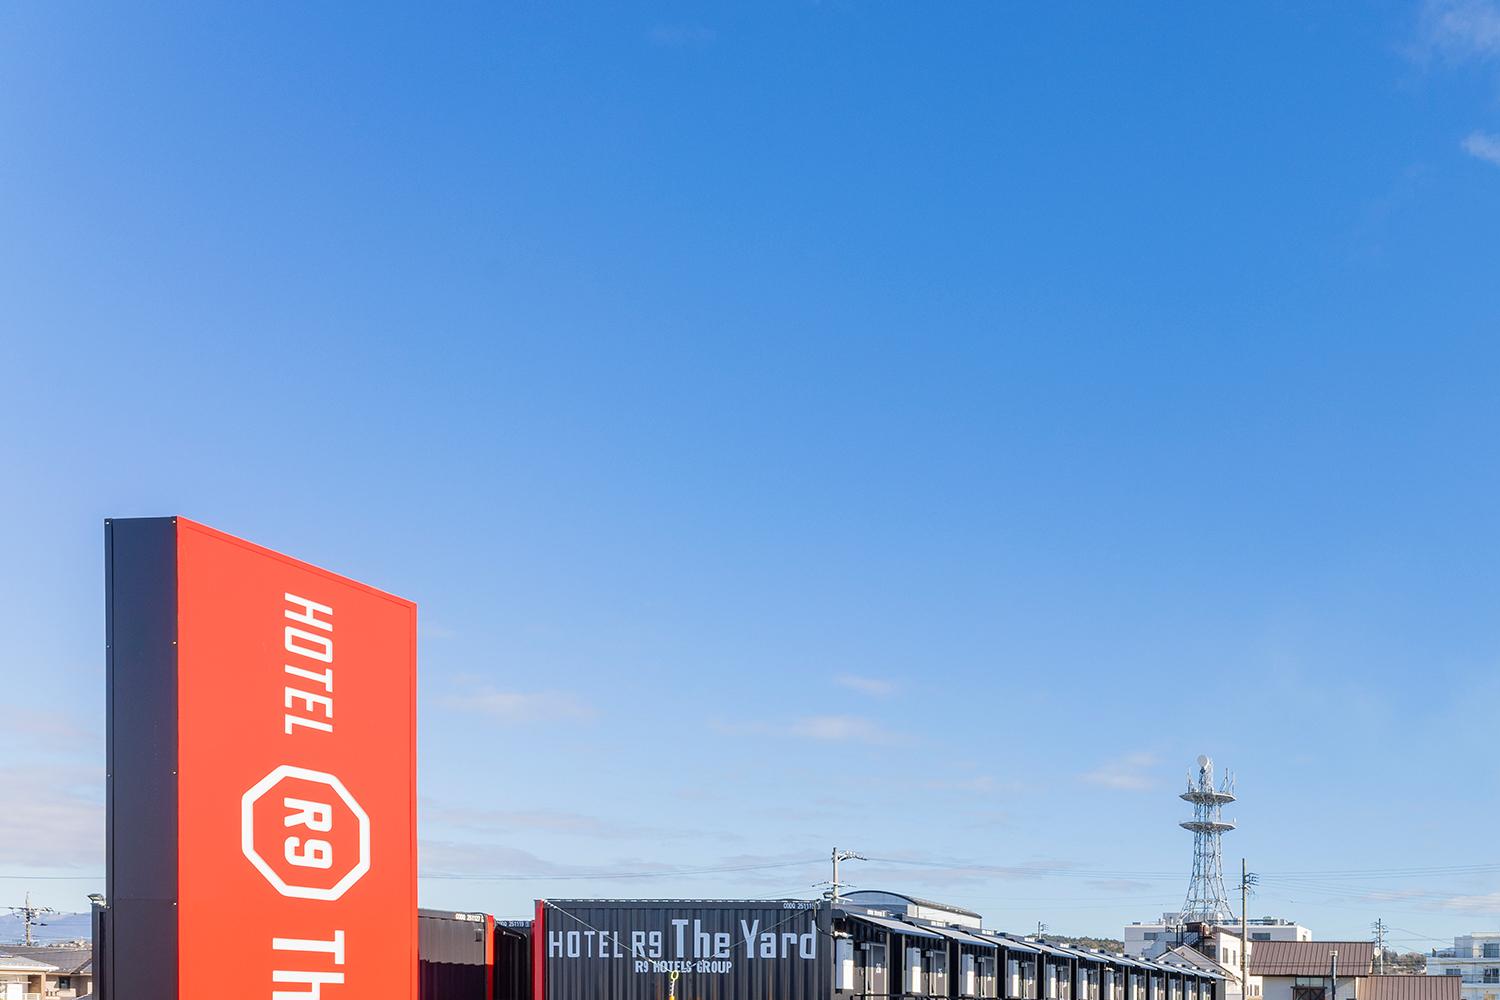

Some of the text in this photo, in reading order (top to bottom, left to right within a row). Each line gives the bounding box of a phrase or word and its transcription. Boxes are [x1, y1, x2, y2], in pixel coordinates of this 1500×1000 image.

[284, 592, 334, 735] HOTEL
[284, 797, 333, 870] R9
[549, 919, 817, 960] HOTEL R9 The Yard
[634, 960, 733, 974] R9 HOTELS GROUP
